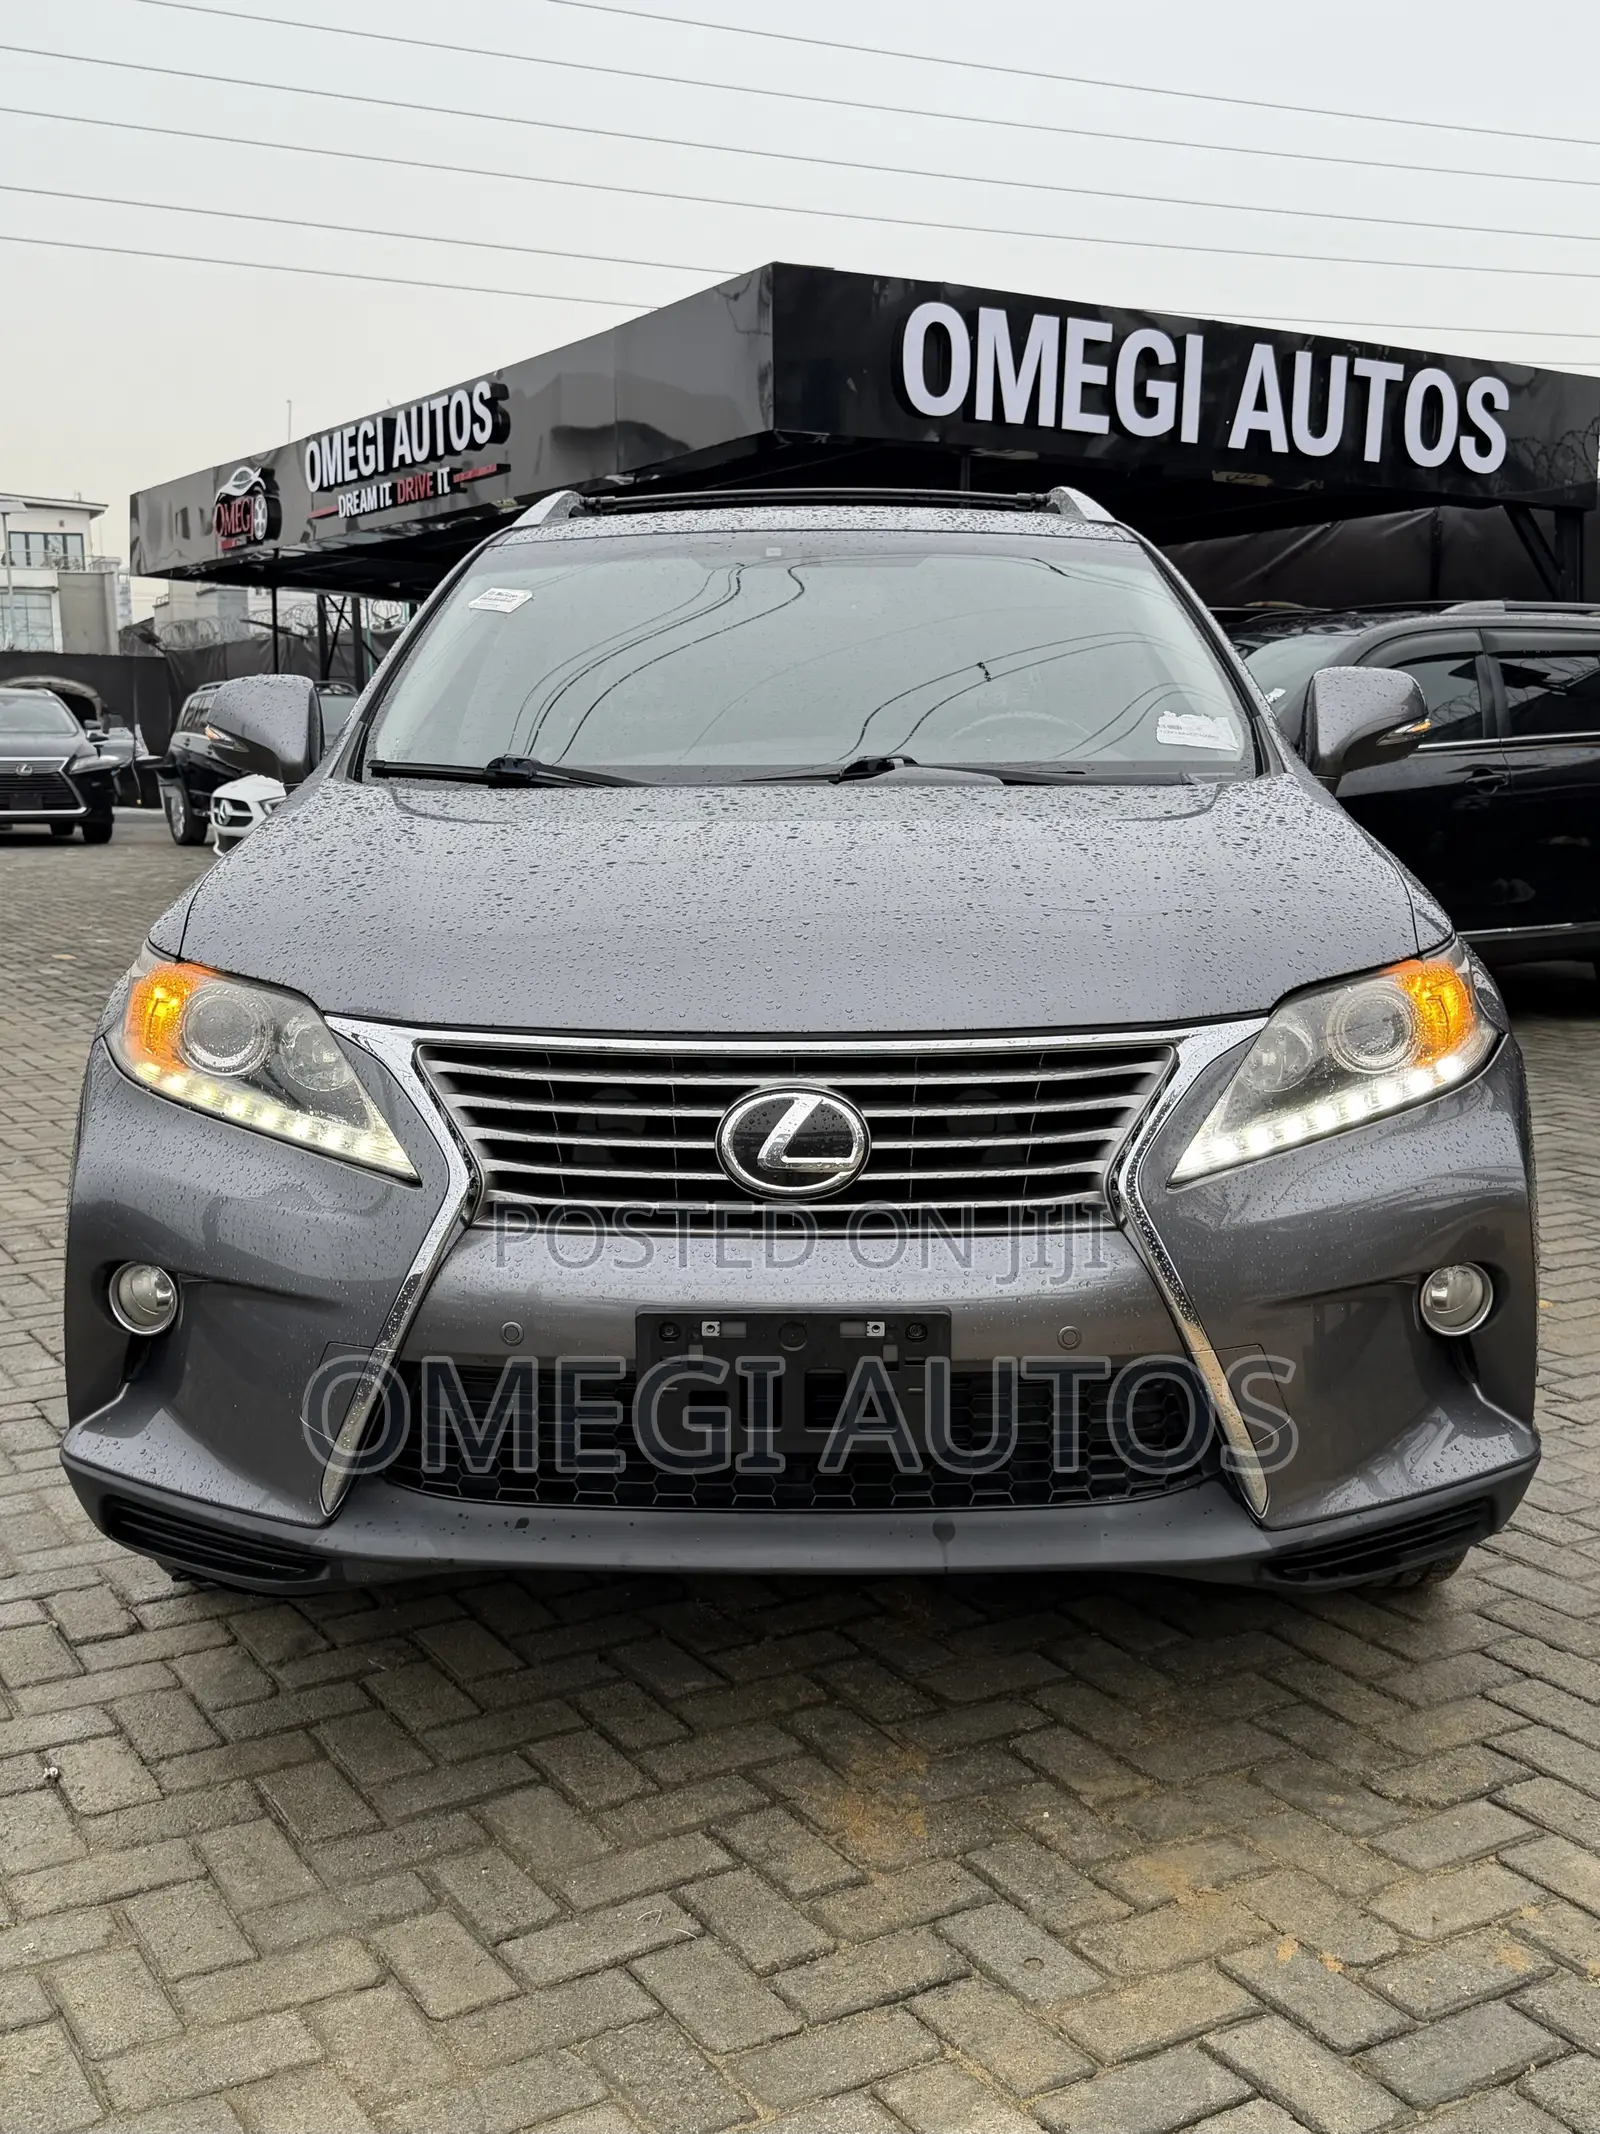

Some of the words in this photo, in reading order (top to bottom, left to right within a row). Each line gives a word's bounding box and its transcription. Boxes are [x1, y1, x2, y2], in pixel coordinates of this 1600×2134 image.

[902, 301, 1204, 445] OMEGI
[1228, 343, 1510, 475] AUTOS
[304, 416, 385, 493] OMEGI
[392, 381, 493, 468] AUTOS
[213, 497, 255, 541] OMEGI
[337, 485, 377, 518] DREAM
[396, 471, 434, 504] DRIVE
[436, 466, 451, 495] IT
